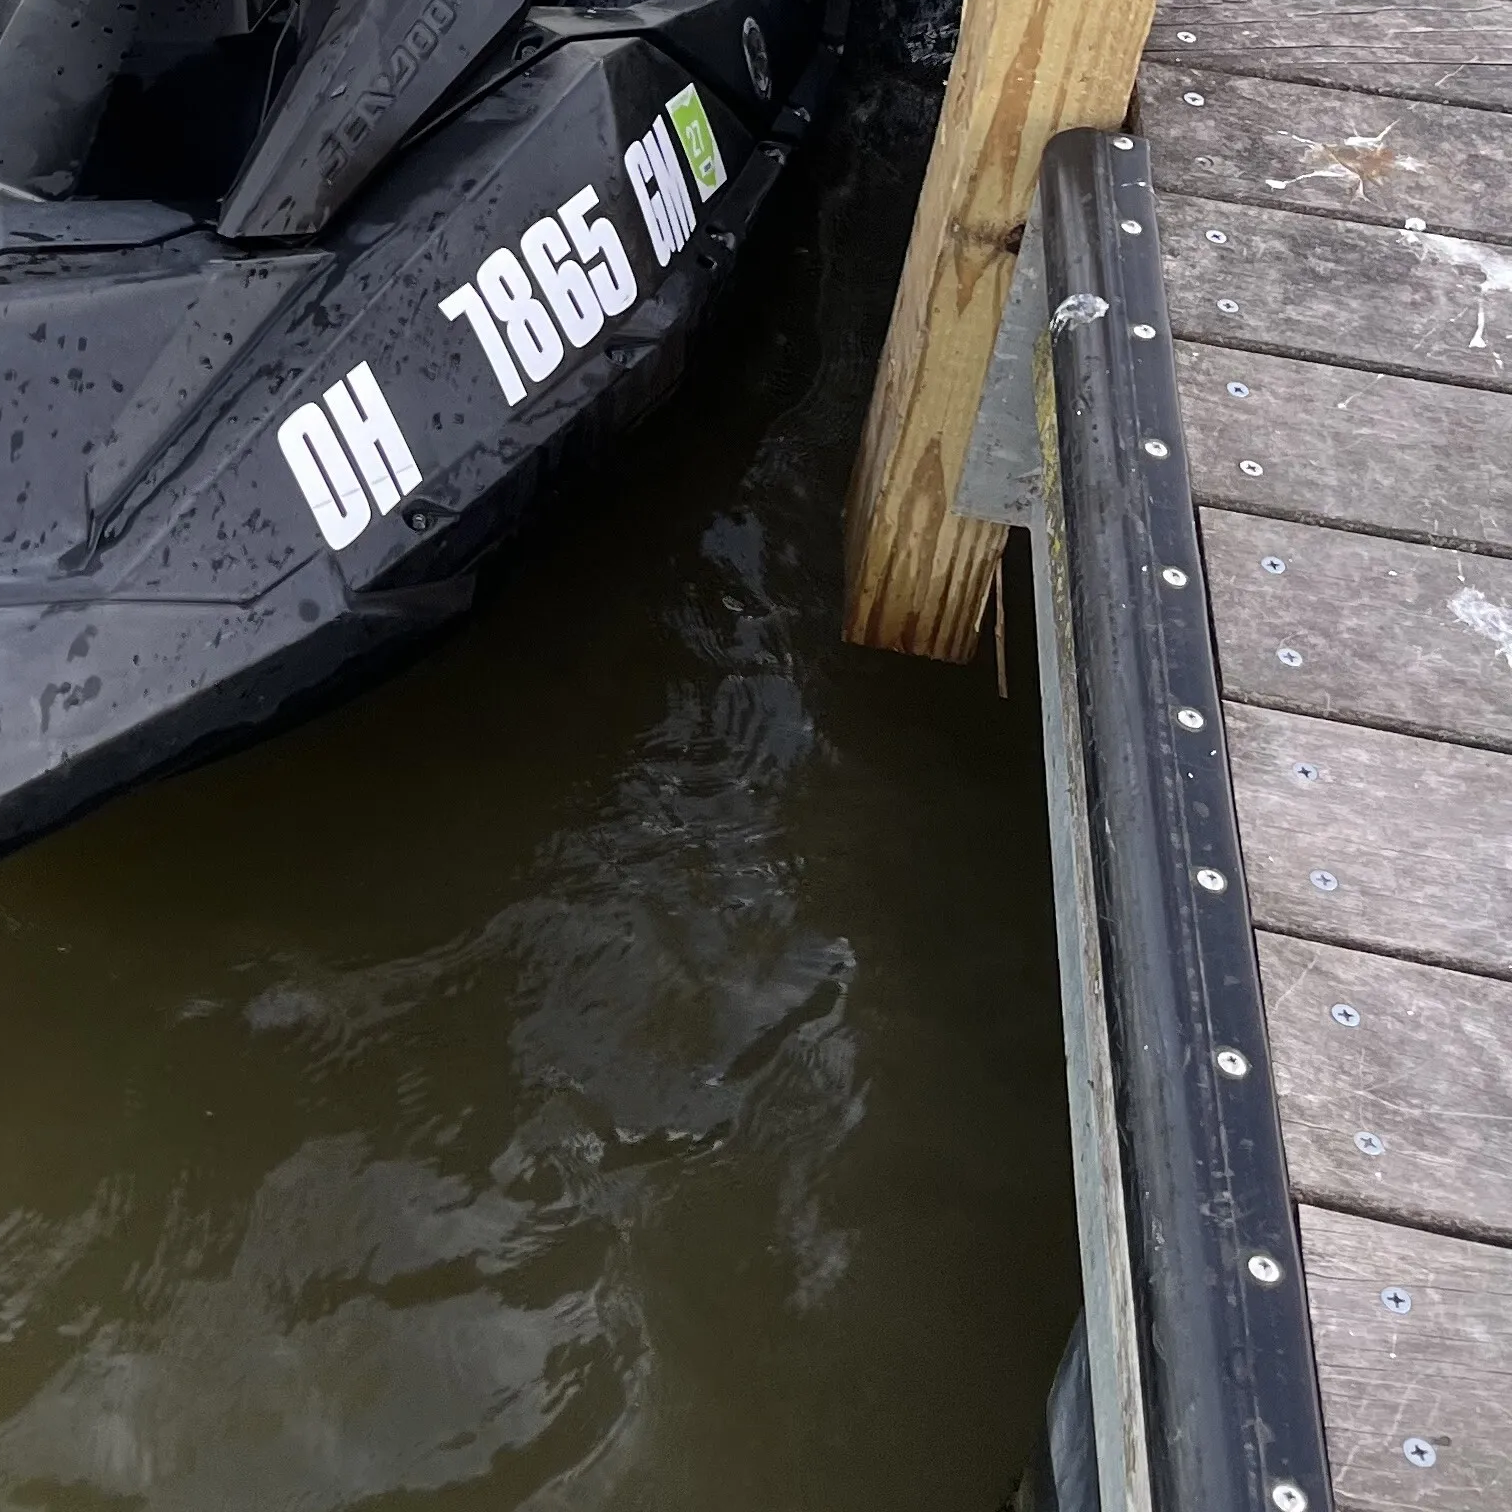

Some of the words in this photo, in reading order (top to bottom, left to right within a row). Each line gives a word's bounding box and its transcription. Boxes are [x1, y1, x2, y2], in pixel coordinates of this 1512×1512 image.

[685, 119, 705, 159] 27
[277, 360, 423, 551] OH
[438, 184, 638, 407] 7865
[623, 114, 697, 268] GM
